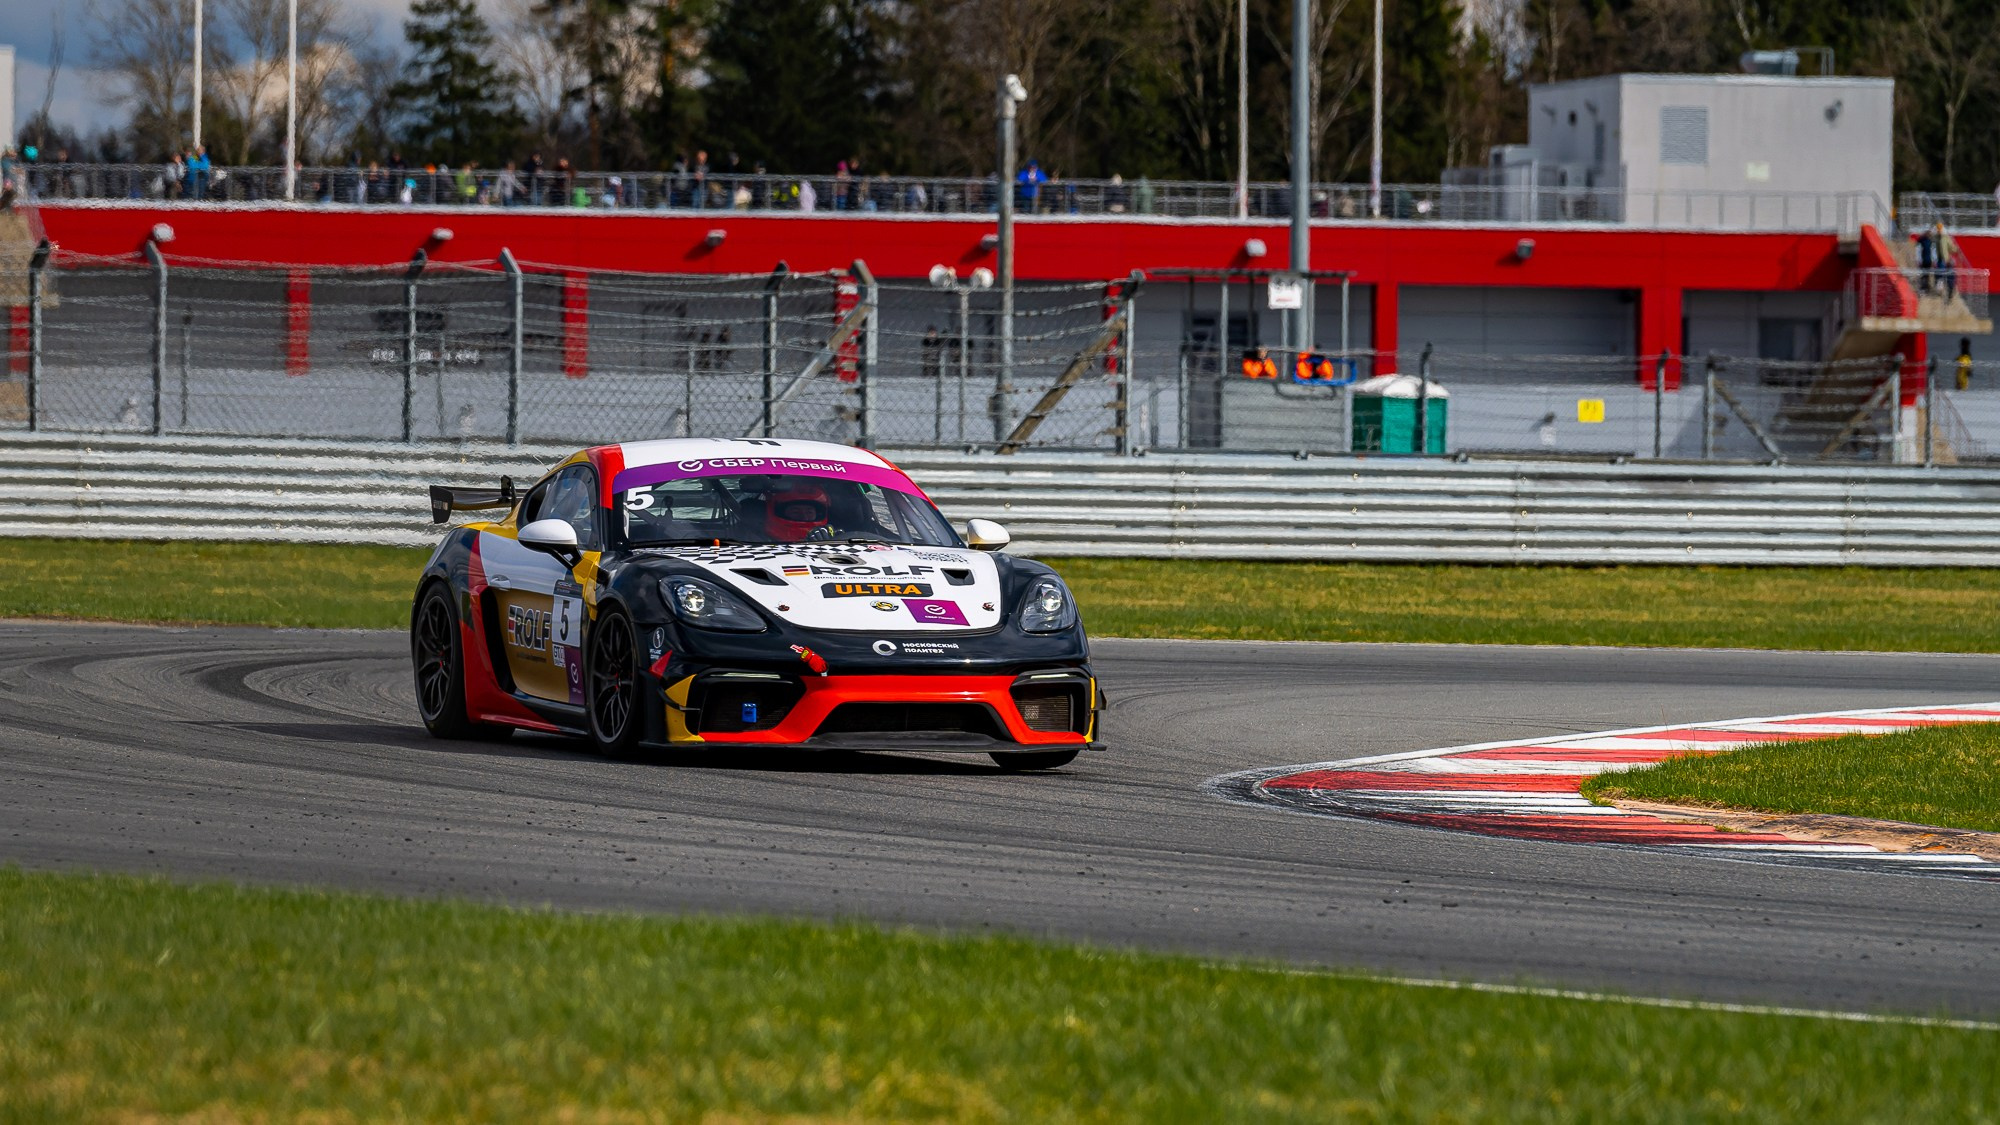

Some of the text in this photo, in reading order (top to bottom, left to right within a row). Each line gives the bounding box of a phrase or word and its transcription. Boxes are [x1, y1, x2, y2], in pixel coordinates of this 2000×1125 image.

[708, 458, 847, 474] СБЕР Первый
[622, 485, 655, 511] 5
[809, 565, 935, 576] ROLF
[835, 584, 923, 595] ULTRA
[514, 605, 552, 652] ROLF
[559, 599, 570, 641] 5
